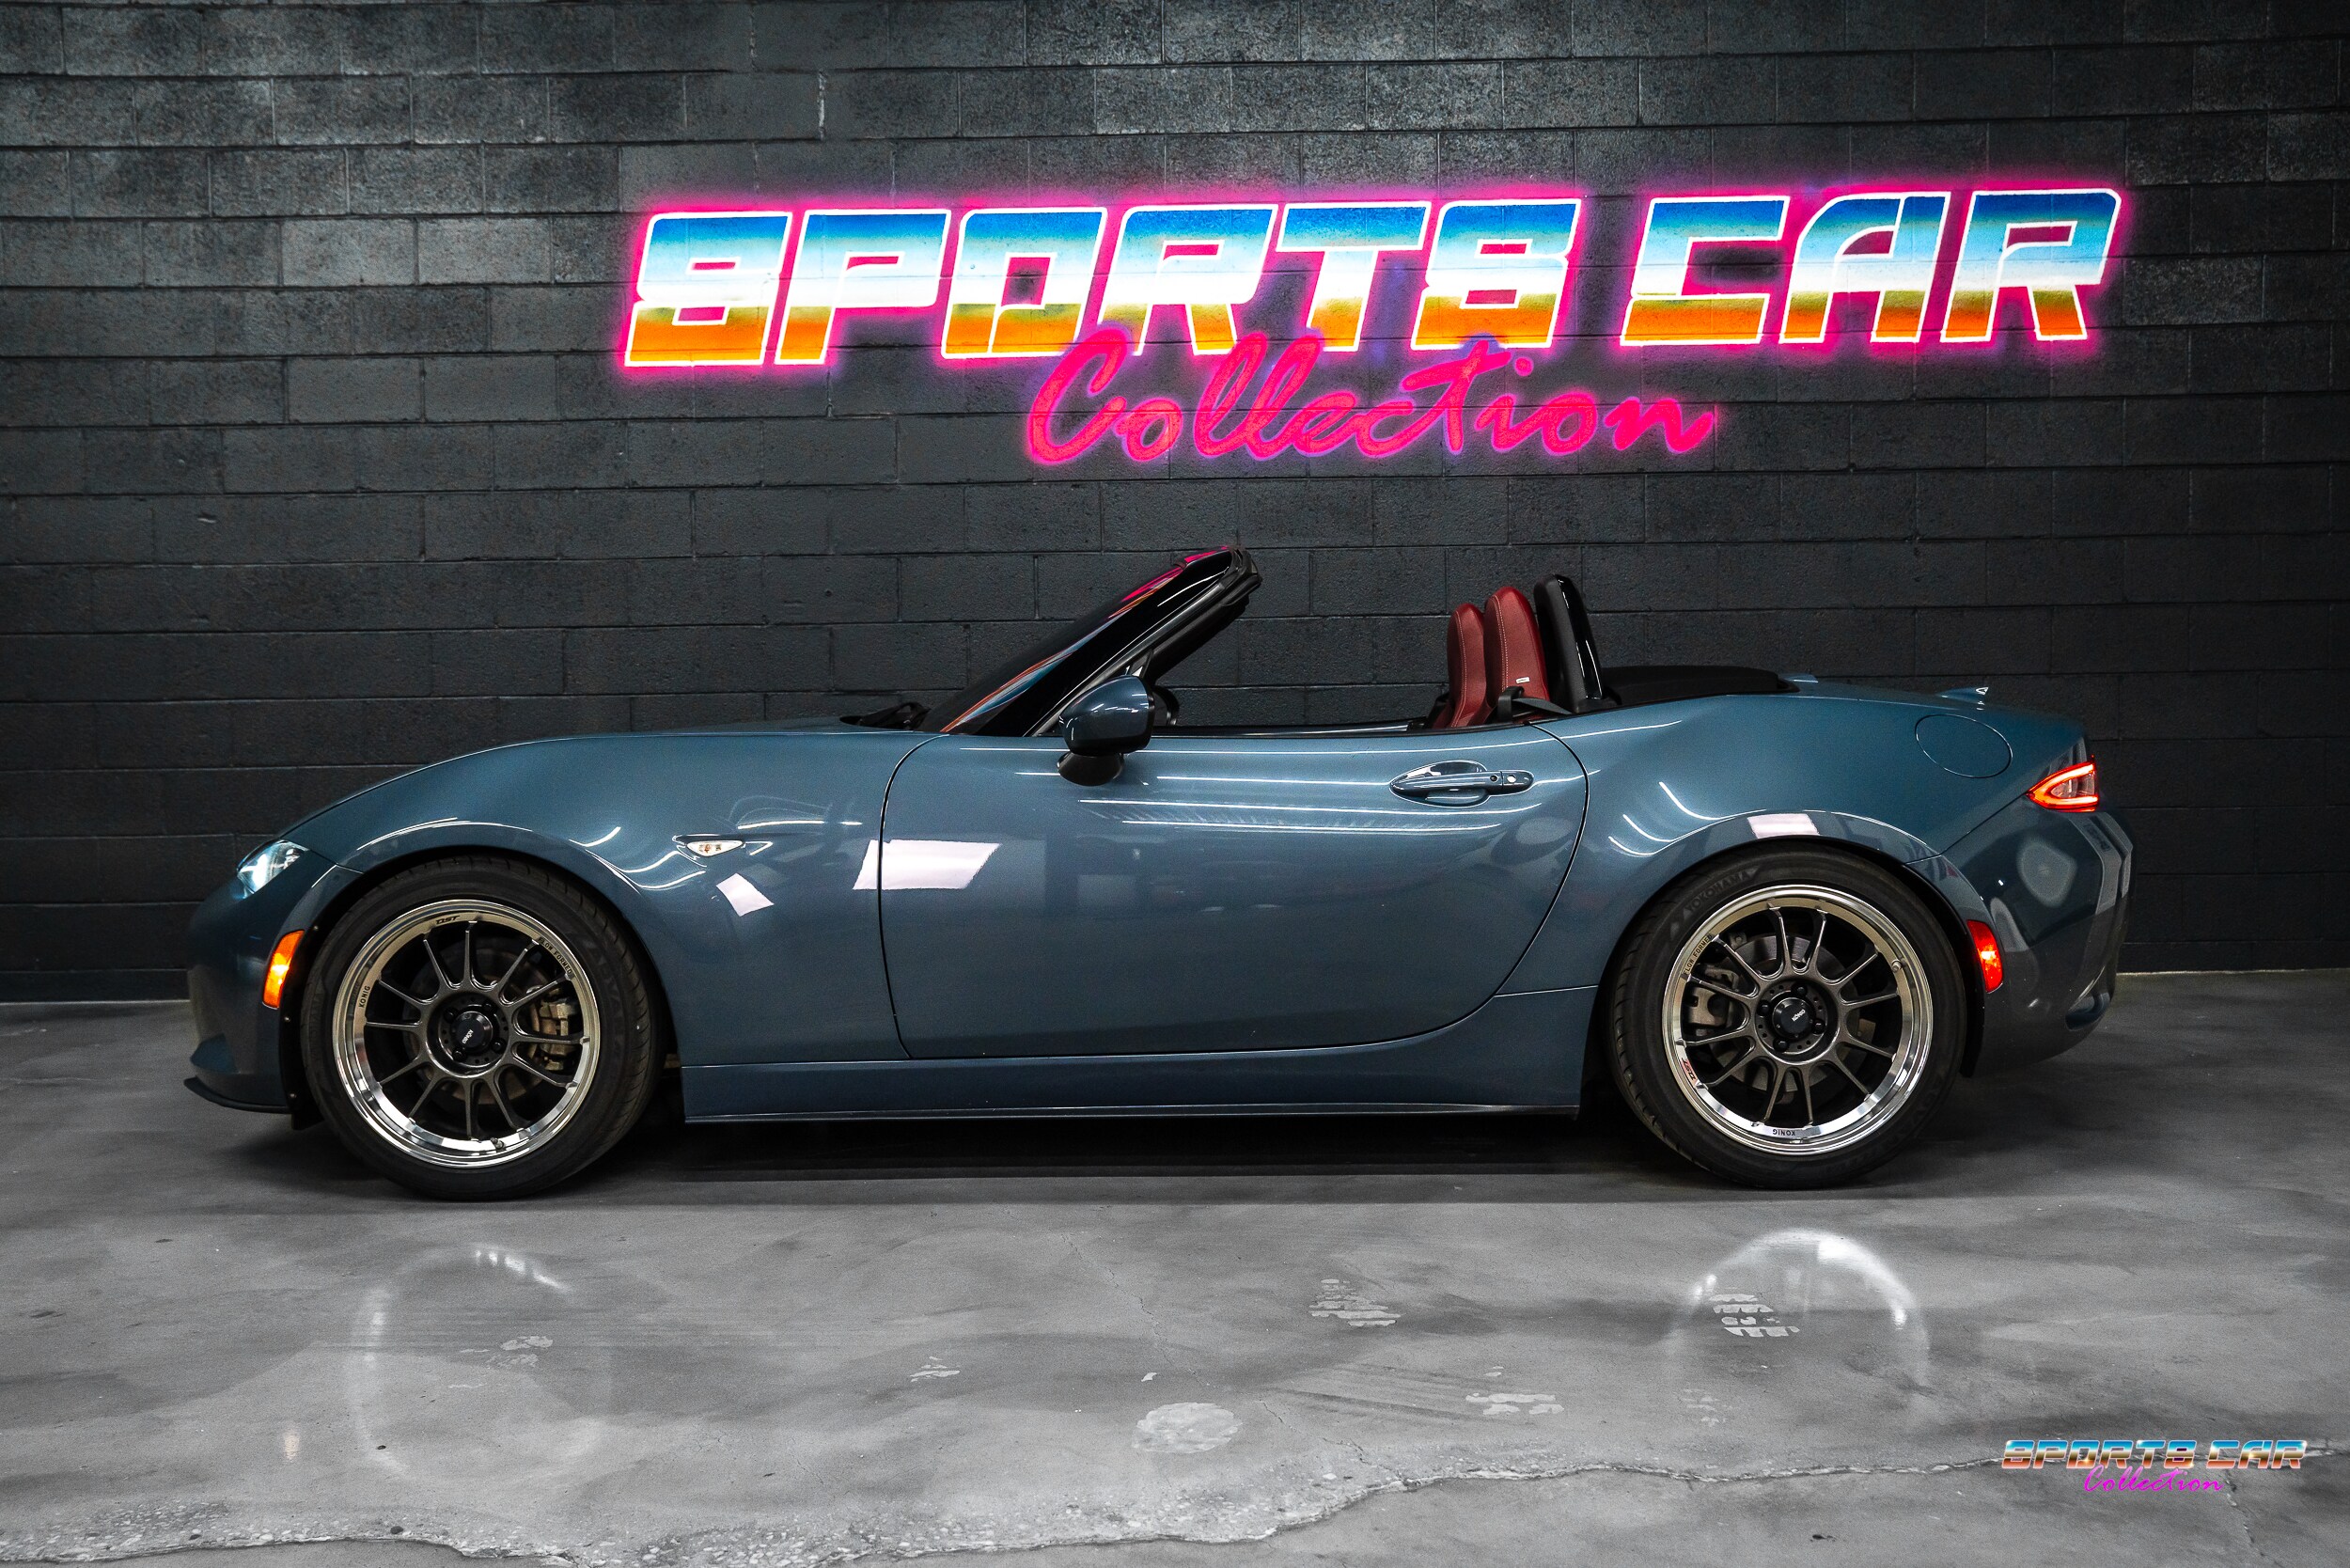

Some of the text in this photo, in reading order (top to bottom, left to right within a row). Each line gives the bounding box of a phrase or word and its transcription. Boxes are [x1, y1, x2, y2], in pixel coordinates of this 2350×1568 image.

[624, 188, 2122, 368] SPORTS CAR
[1028, 328, 1716, 464] Collection
[358, 985, 371, 1008] KONIG
[1772, 1128, 1796, 1137] KONIG
